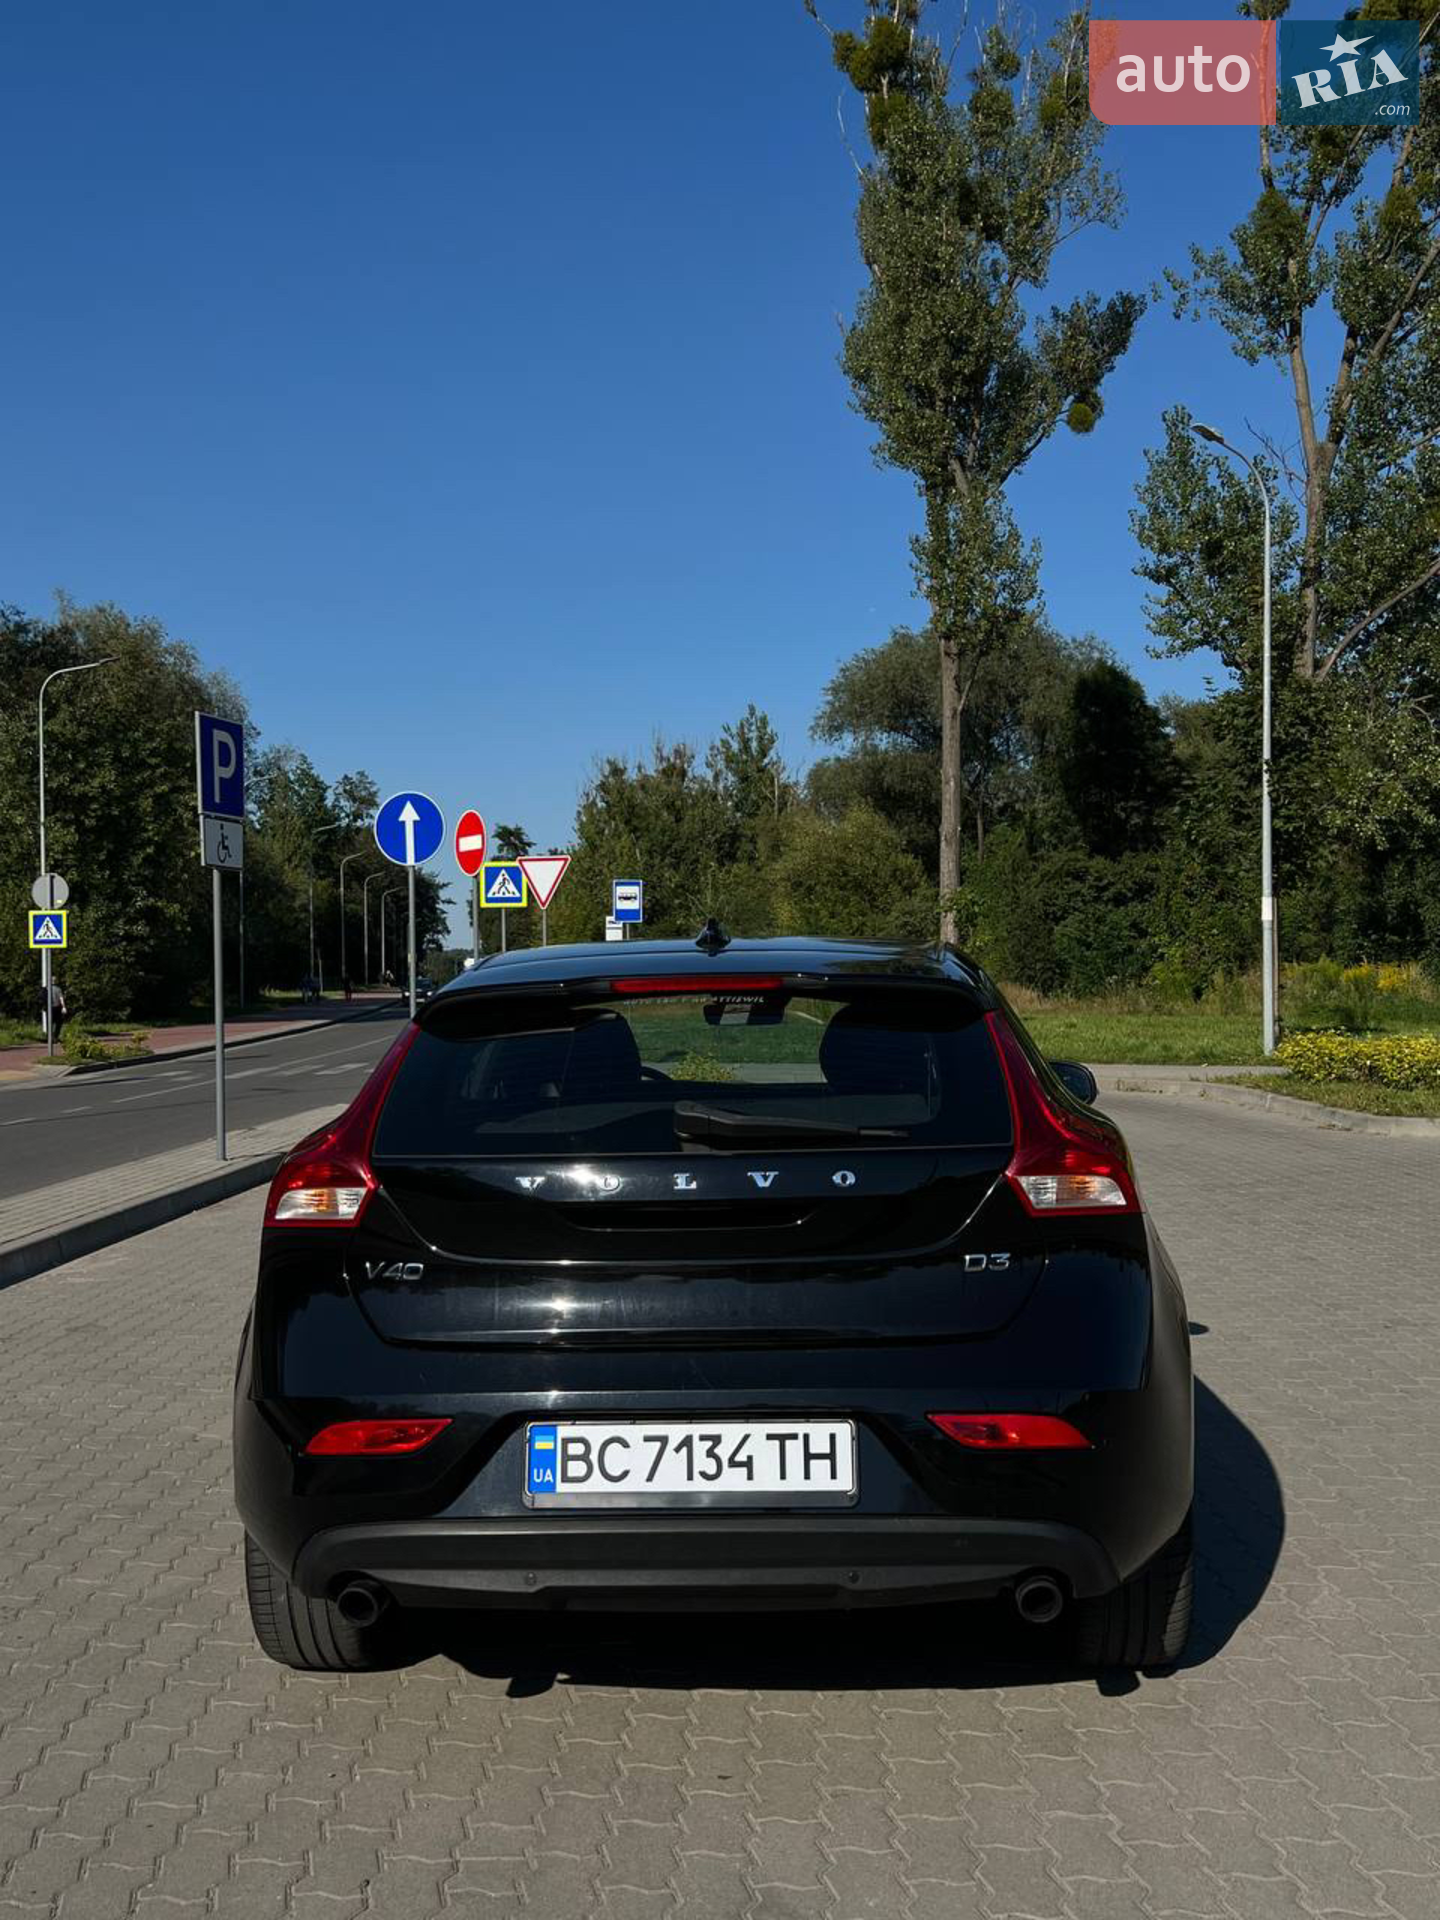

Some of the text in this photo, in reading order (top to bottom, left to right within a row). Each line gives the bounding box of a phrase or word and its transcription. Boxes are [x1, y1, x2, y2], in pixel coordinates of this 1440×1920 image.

[212, 728, 237, 804] P
[515, 1169, 857, 1195] VOLVO
[365, 1260, 425, 1281] V40
[964, 1252, 1011, 1273] D3
[560, 1432, 838, 1484] BC 7134 TH
[533, 1467, 555, 1484] UA
